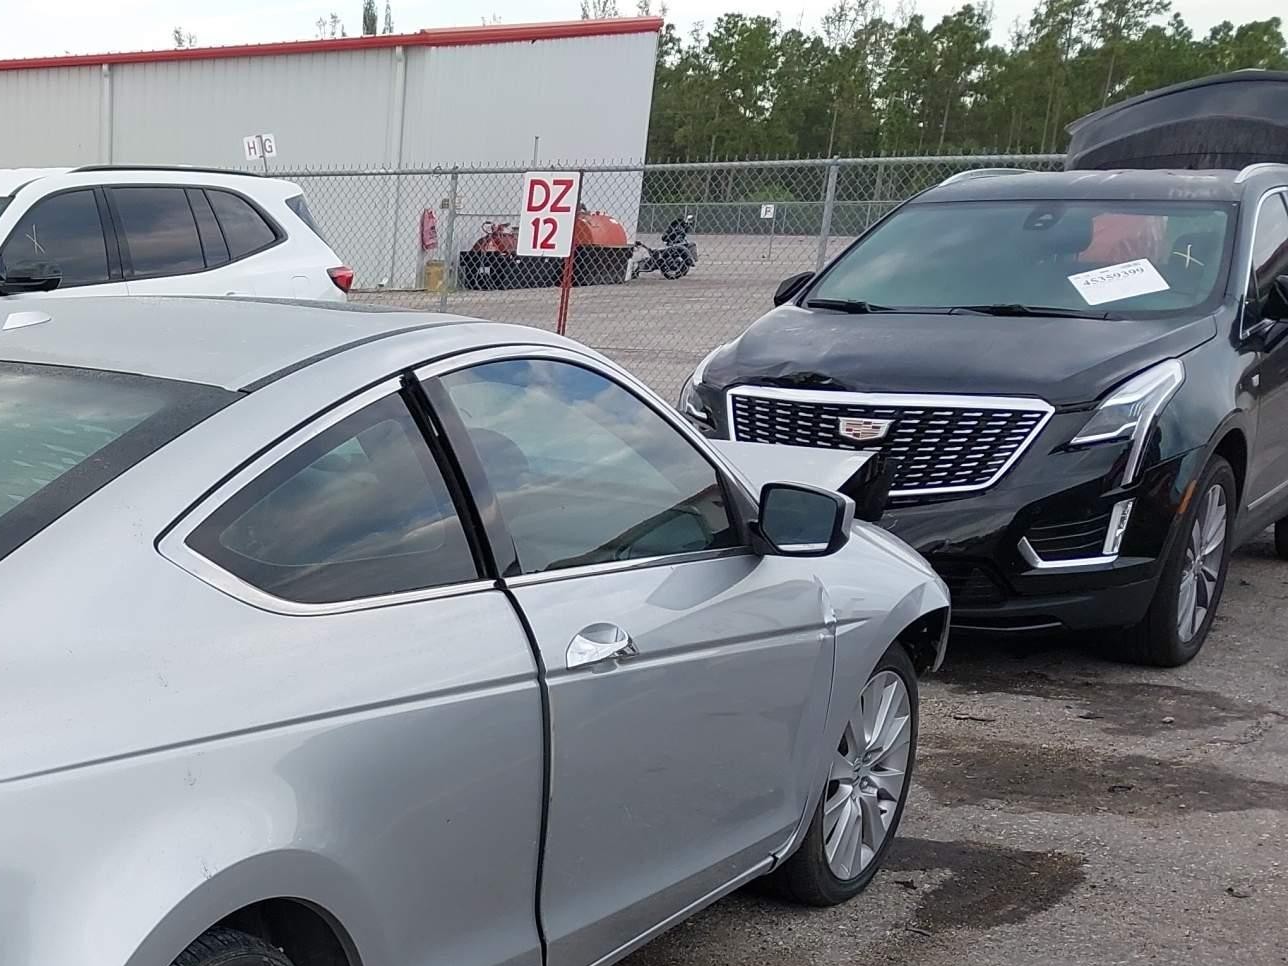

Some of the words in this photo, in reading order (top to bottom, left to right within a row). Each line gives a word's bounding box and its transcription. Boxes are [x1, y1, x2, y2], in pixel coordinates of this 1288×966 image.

[247, 140, 257, 156] H
[263, 138, 274, 154] G
[526, 179, 574, 213] DZ
[530, 217, 559, 250] 12
